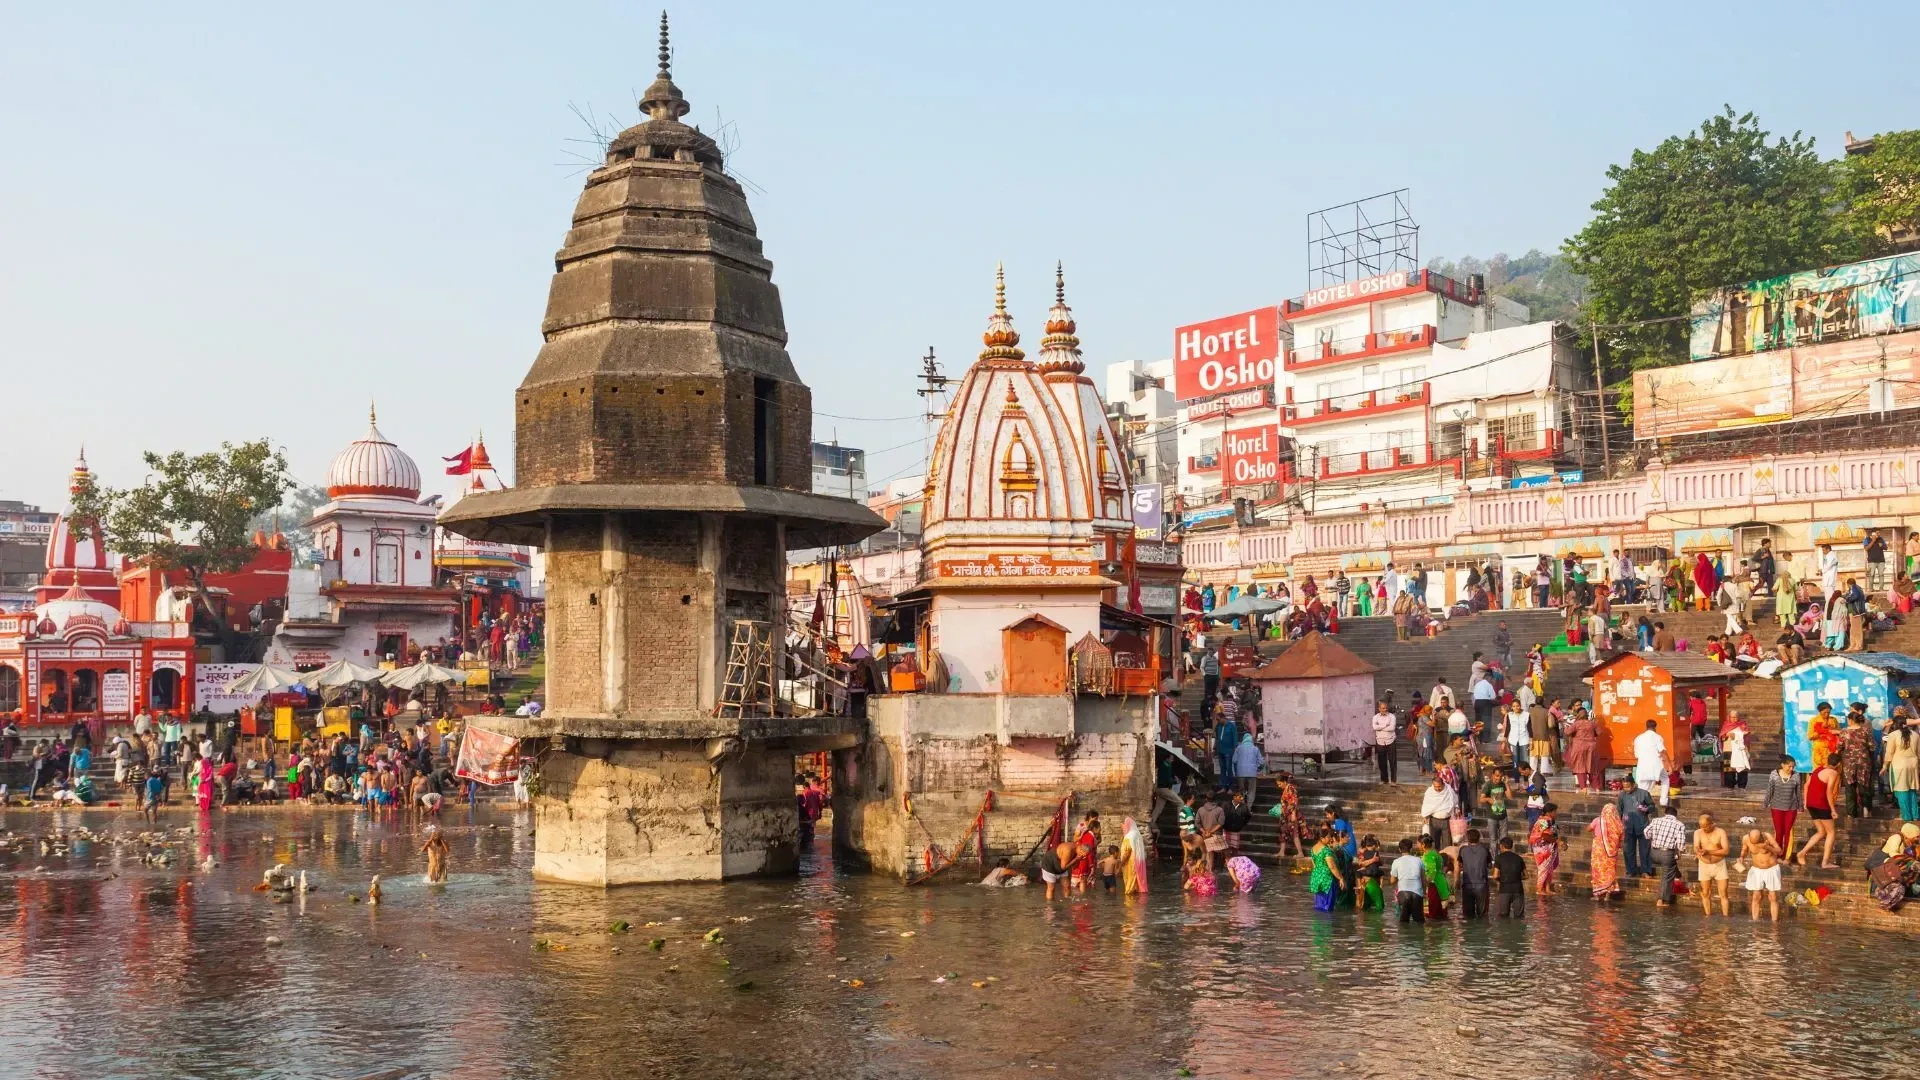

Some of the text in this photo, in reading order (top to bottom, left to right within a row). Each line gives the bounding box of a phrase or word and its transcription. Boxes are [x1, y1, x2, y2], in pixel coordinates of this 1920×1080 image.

[1307, 272, 1404, 307] HOTEL OSHO
[1199, 353, 1274, 391] Osho
[1229, 392, 1261, 409] OSHO
[1235, 456, 1276, 481] Osho
